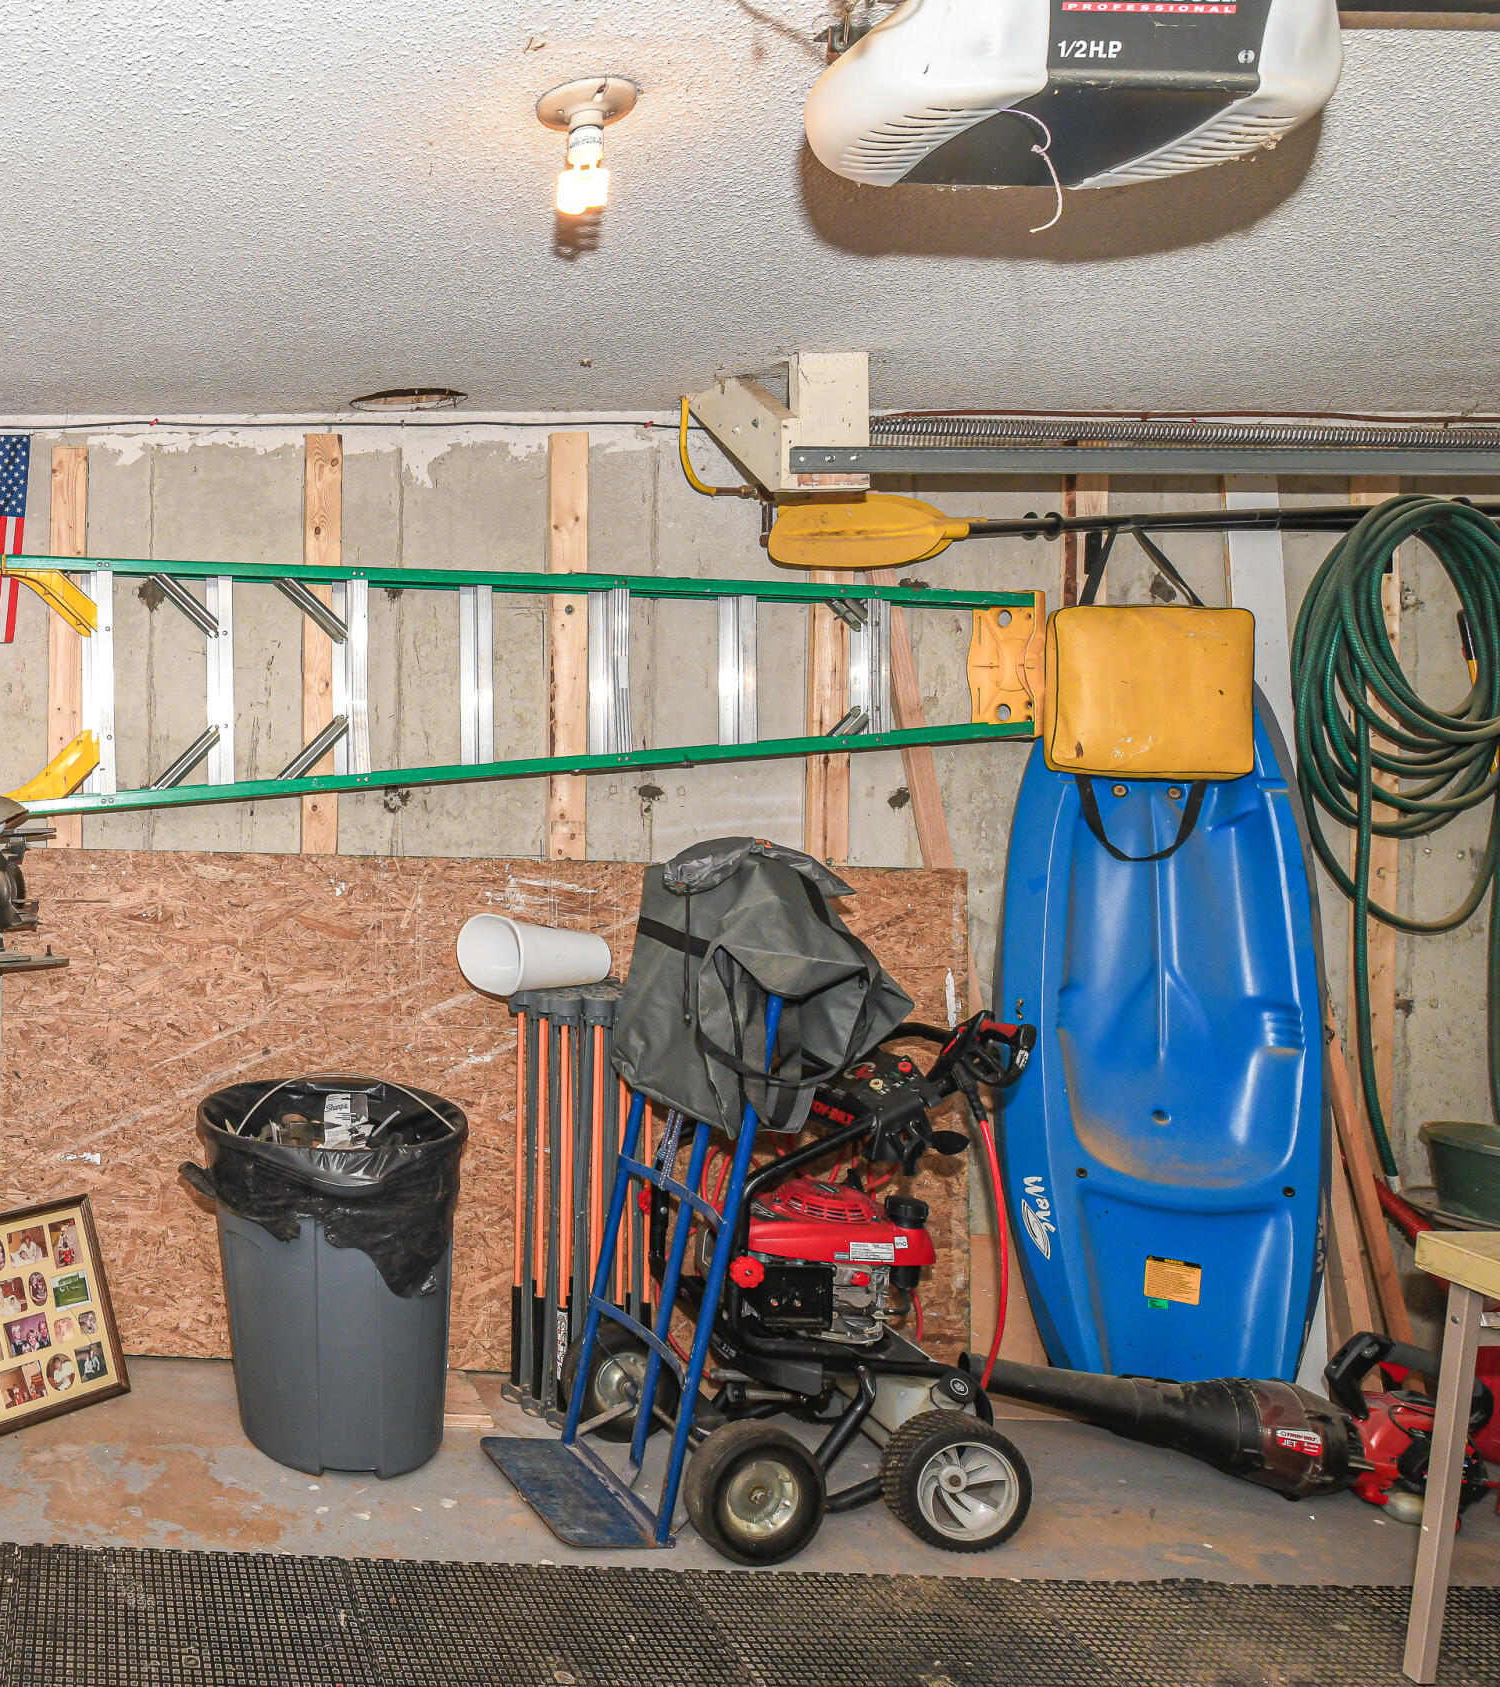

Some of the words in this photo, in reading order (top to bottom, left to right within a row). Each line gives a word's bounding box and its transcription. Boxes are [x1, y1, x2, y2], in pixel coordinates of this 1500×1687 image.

[1066, 3, 1233, 13] PROFESSIONAL
[812, 1100, 855, 1126] OY-BILT
[1281, 1439, 1298, 1448] JET
